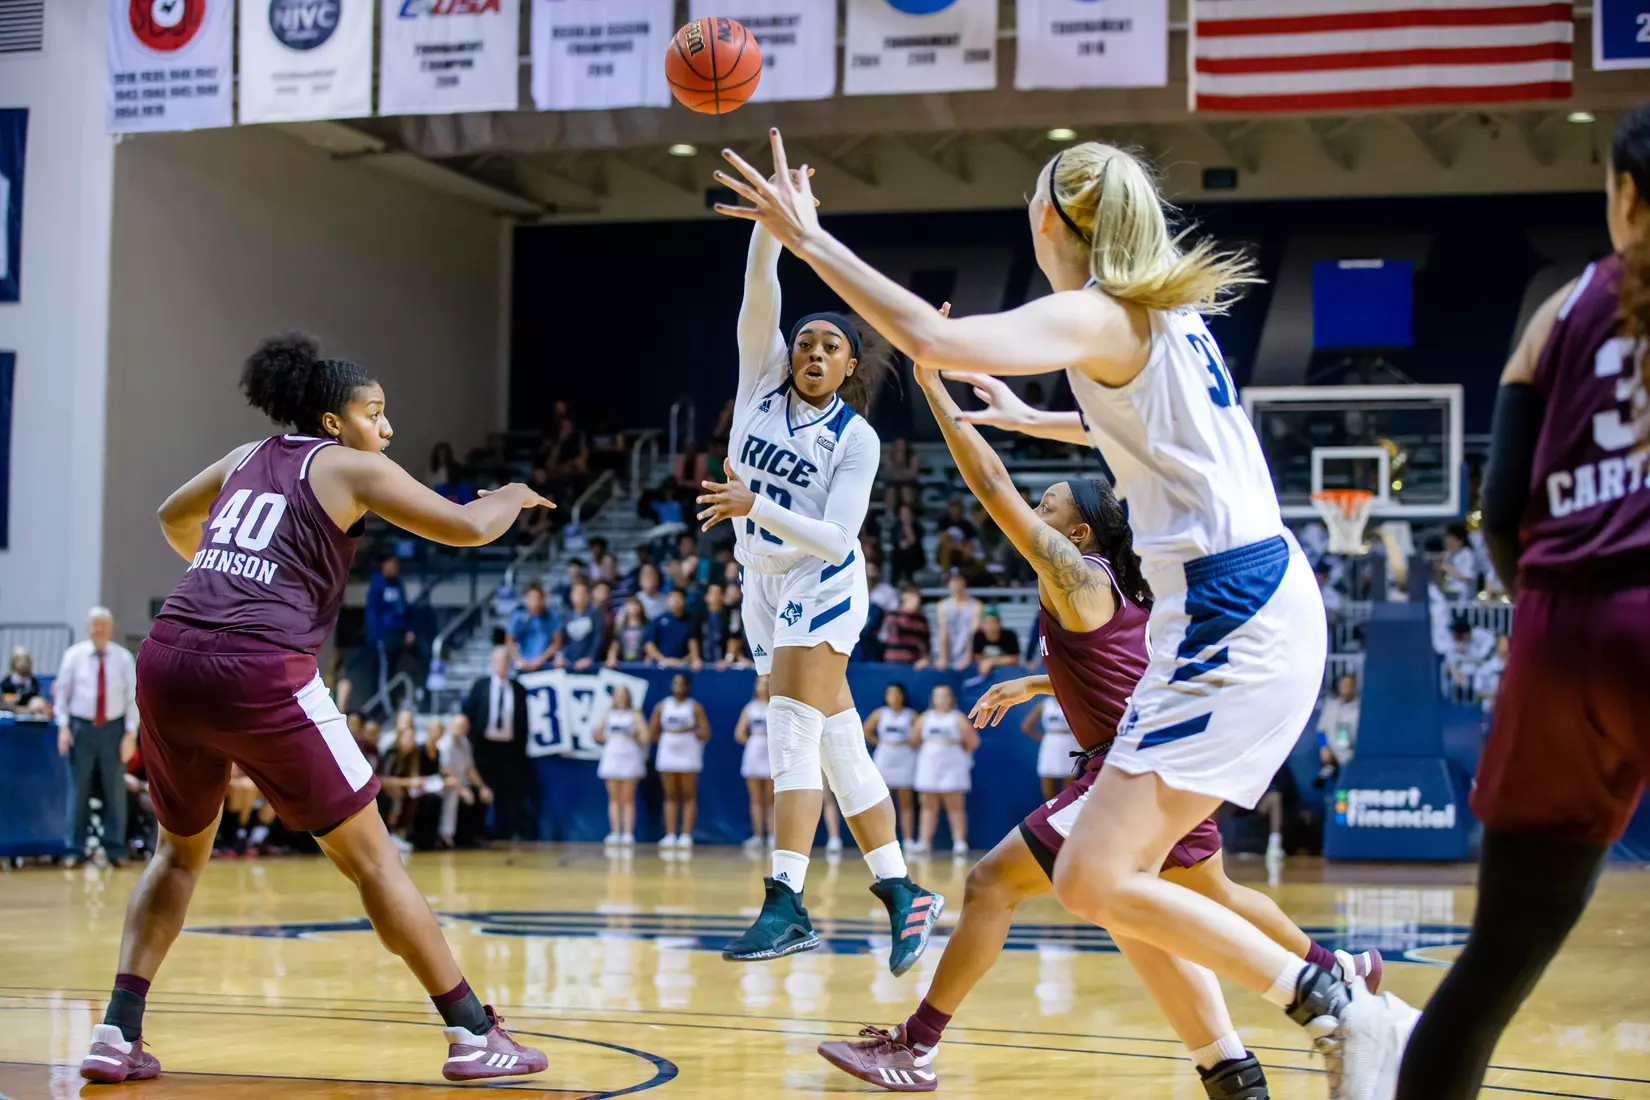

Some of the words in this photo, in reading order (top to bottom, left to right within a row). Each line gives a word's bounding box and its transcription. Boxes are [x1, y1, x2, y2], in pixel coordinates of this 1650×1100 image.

[740, 434, 818, 488] RICE
[1547, 455, 1650, 518] CART
[209, 488, 288, 552] 40
[1347, 787, 1421, 808] smart
[1347, 804, 1456, 829] financial
